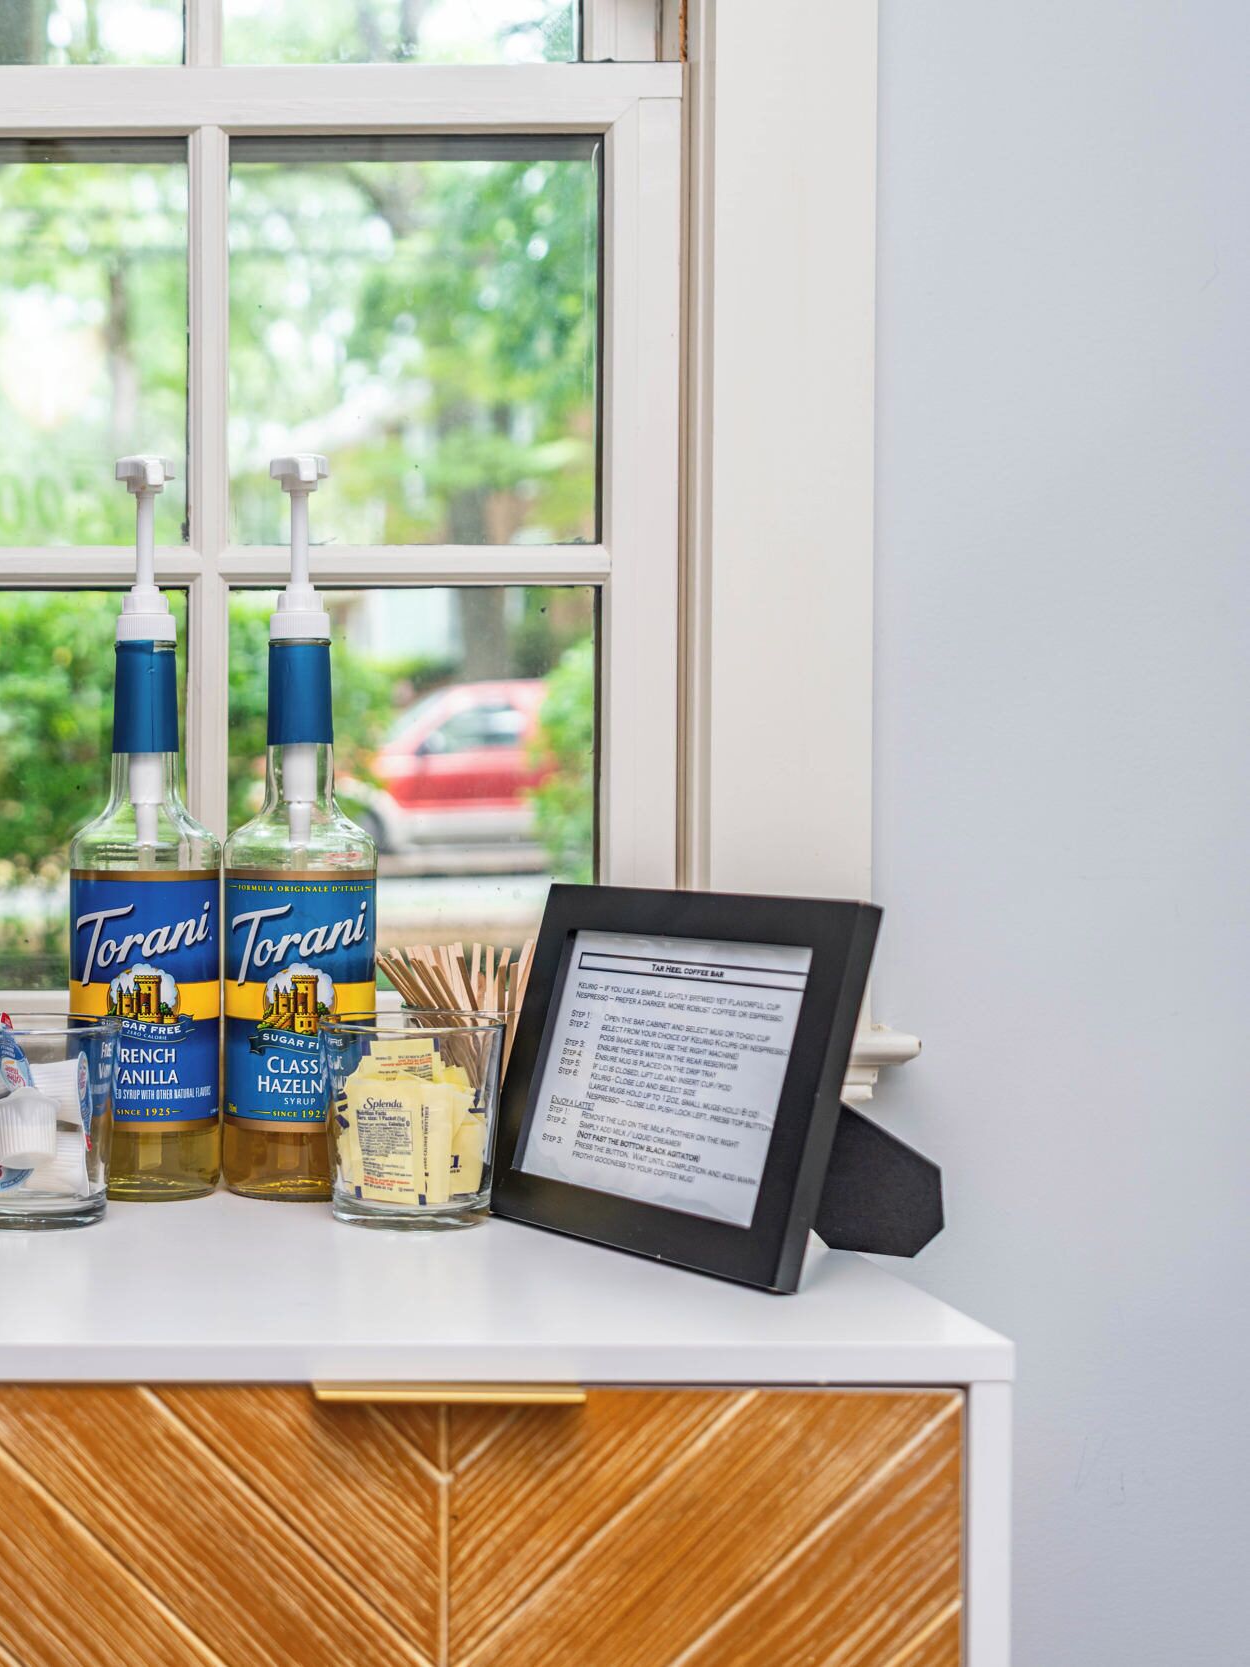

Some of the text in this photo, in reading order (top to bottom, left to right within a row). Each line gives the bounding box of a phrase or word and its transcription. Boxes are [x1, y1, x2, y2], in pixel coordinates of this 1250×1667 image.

[238, 884, 274, 892] FORMULA
[76, 900, 211, 986] Torani
[231, 900, 367, 986] Torani
[683, 966, 708, 975] COFFEE
[710, 968, 725, 977] BAR
[151, 1025, 181, 1034] FREE
[262, 1033, 304, 1048] SUGAR
[121, 1048, 176, 1064] RENCH
[257, 1075, 323, 1094] HAZELN
[141, 1089, 154, 1100] WITH
[156, 1088, 172, 1100] OTHER
[174, 1087, 195, 1099] NATURAL
[363, 1097, 402, 1110] Splenda
[145, 1107, 171, 1116] 1925
